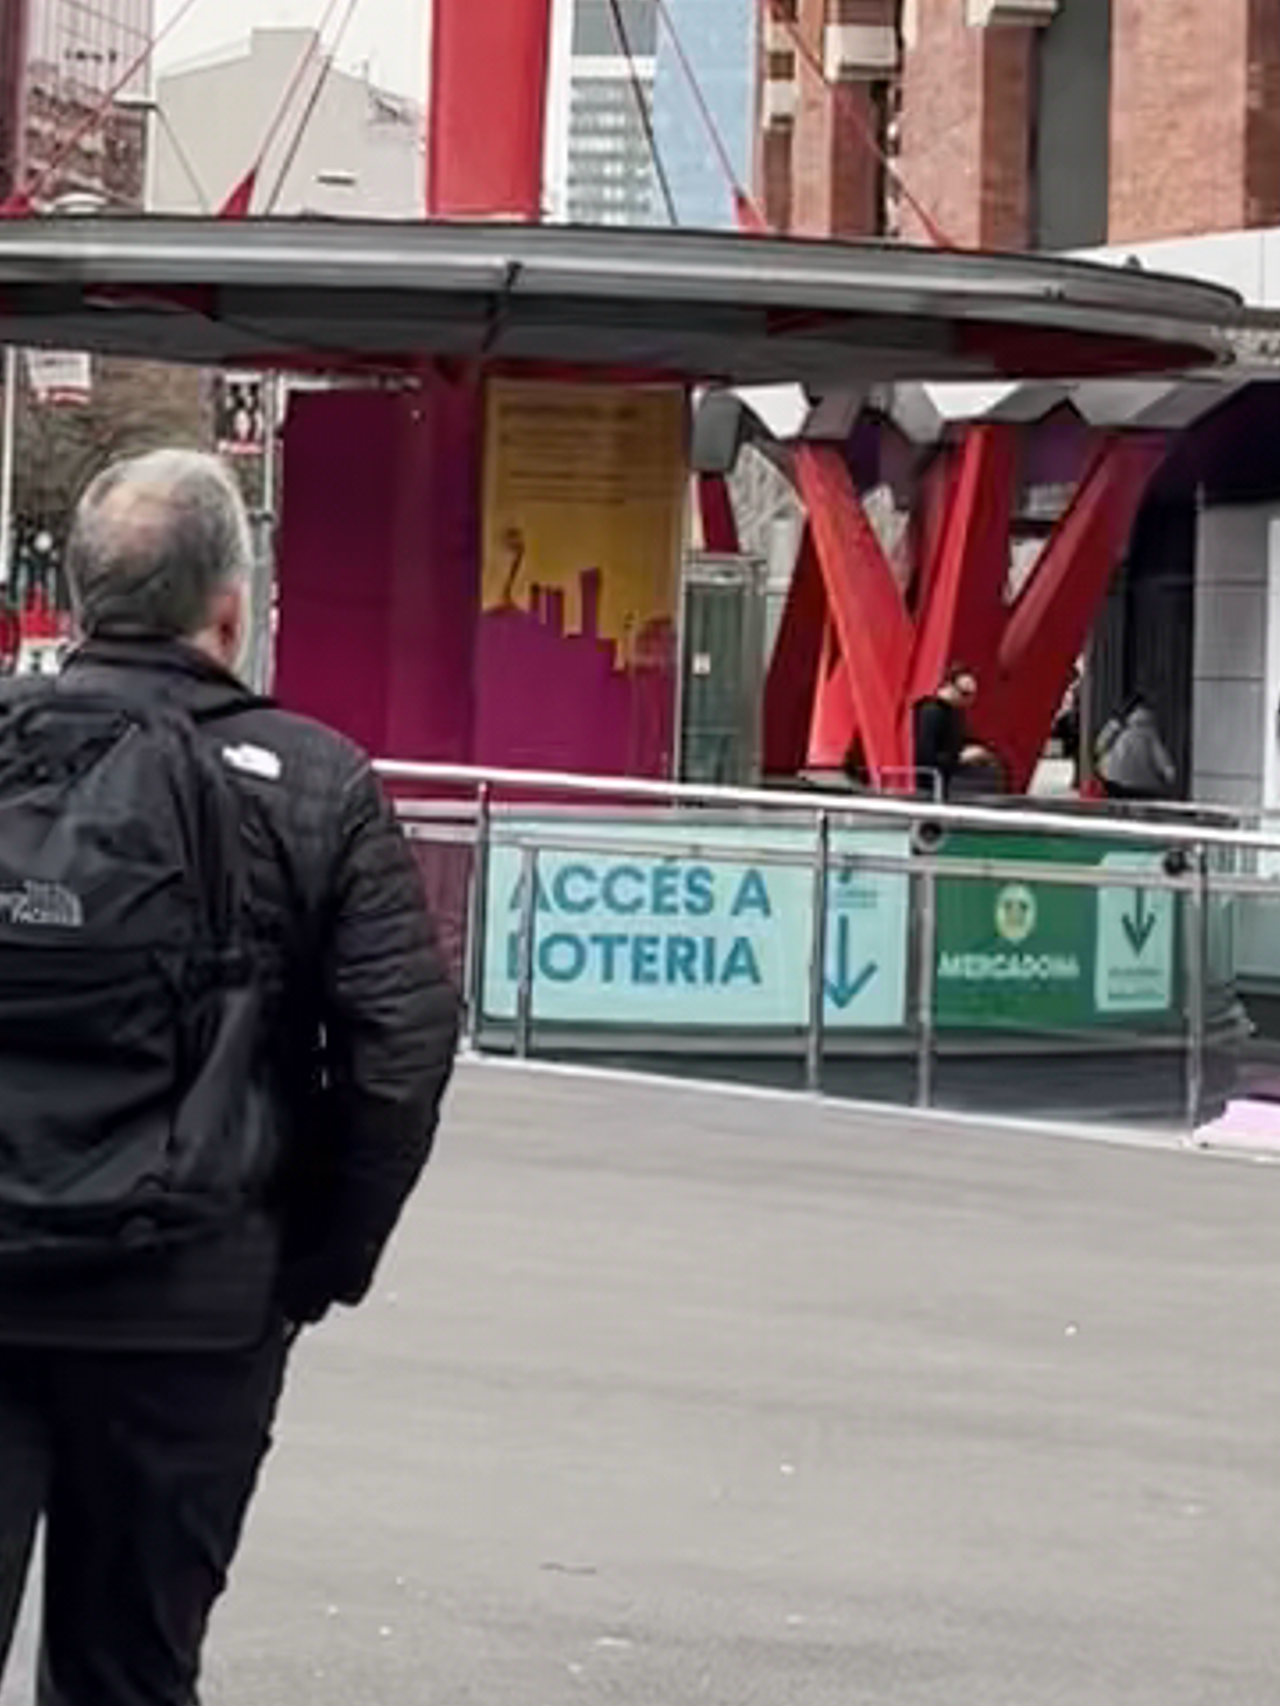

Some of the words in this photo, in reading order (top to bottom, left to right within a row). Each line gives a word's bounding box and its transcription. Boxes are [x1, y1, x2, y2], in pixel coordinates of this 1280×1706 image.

[508, 854, 717, 914] ACCÉS
[730, 868, 771, 918] A
[506, 930, 763, 985] LOTERIA
